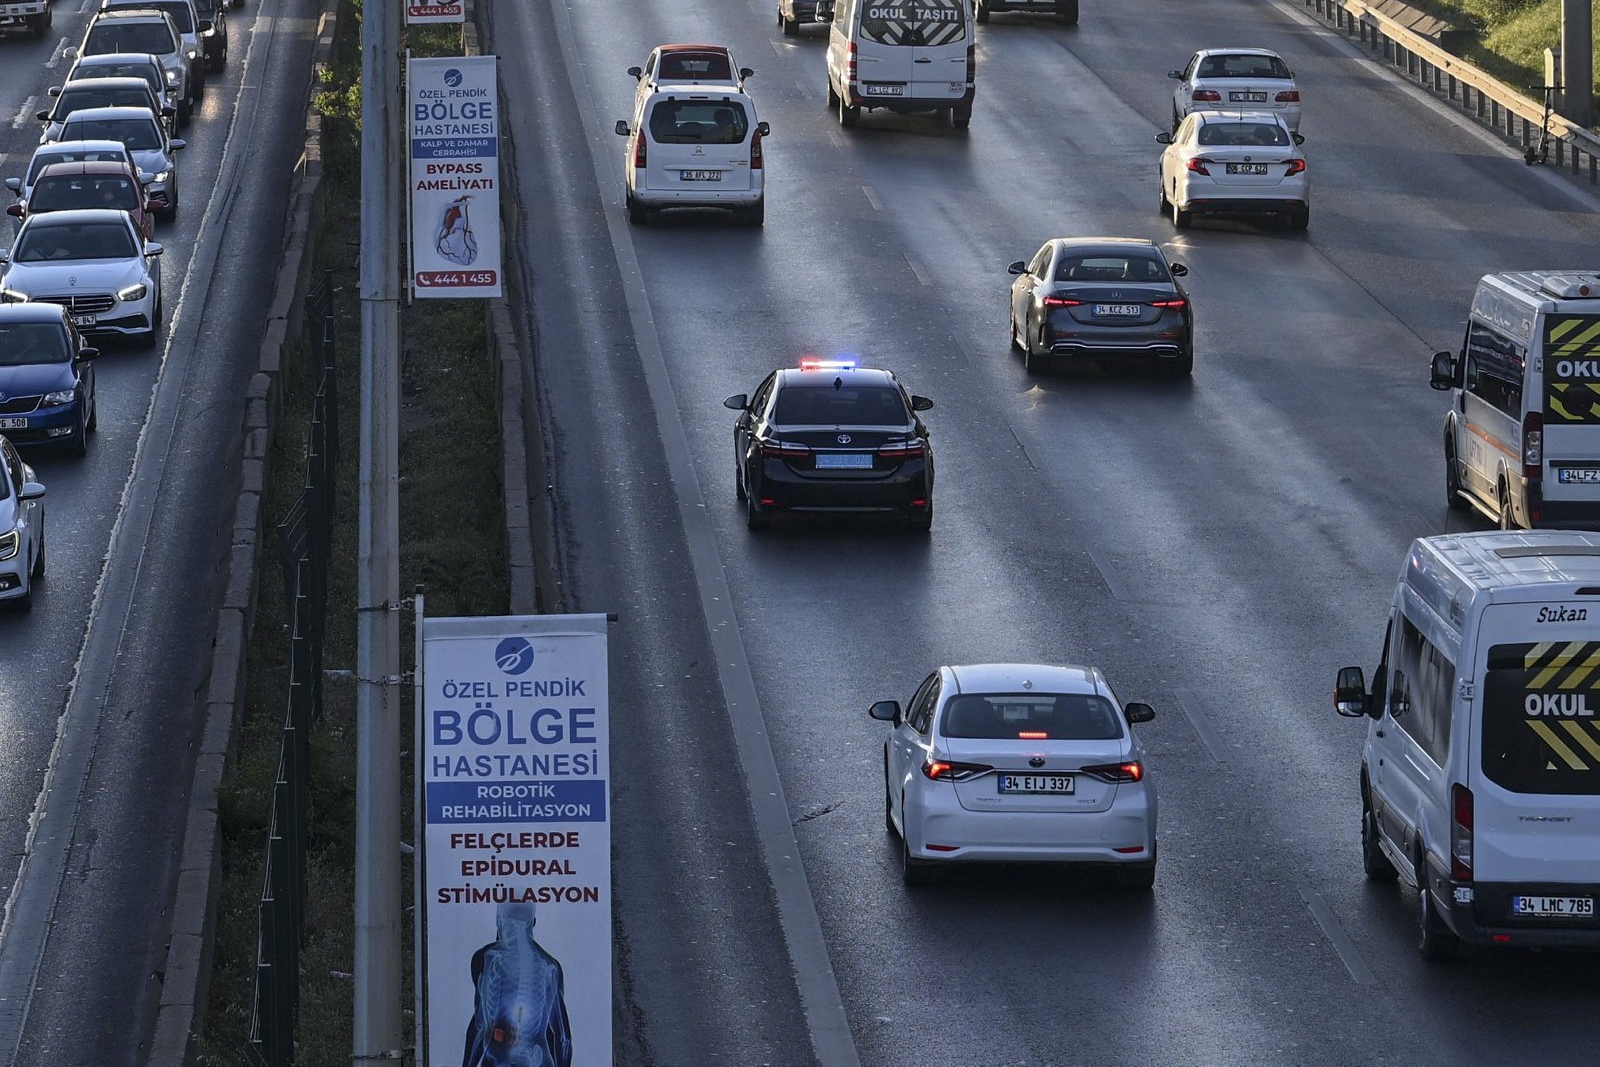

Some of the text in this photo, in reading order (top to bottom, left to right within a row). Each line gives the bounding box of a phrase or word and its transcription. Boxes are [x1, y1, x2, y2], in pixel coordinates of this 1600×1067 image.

[869, 8, 958, 22] OKUL TAŞITI
[419, 87, 487, 99] ÖZEL PENDİK
[414, 99, 492, 121] BÖLGE
[414, 121, 493, 136] HASTANESİ
[420, 140, 441, 148] KALP
[457, 139, 489, 147] DAMAR
[432, 148, 478, 157] CERRAHİSİ
[426, 163, 483, 175] BYPASS
[416, 177, 493, 191] AMELİYATI
[434, 273, 492, 284] 444 1 455
[1097, 304, 1138, 313] 34 KCZ 513
[818, 455, 829, 464] 34
[1536, 605, 1588, 623] Sukan
[442, 677, 586, 699] ÖZEL PENDİK
[1525, 693, 1594, 716] OKUL
[432, 702, 597, 747] BÖLGE
[432, 748, 598, 778] HASTANESİ
[477, 781, 556, 799] ROBOTİK
[1005, 777, 1071, 790] 34 EIJ 337
[441, 800, 591, 819] REHABİLİTASYON
[450, 831, 580, 854] FELÇLERDE
[461, 855, 576, 878] EPİDURAL
[437, 882, 599, 905] STİMÜLASYON
[1520, 897, 1592, 912] 34 LMC 785
